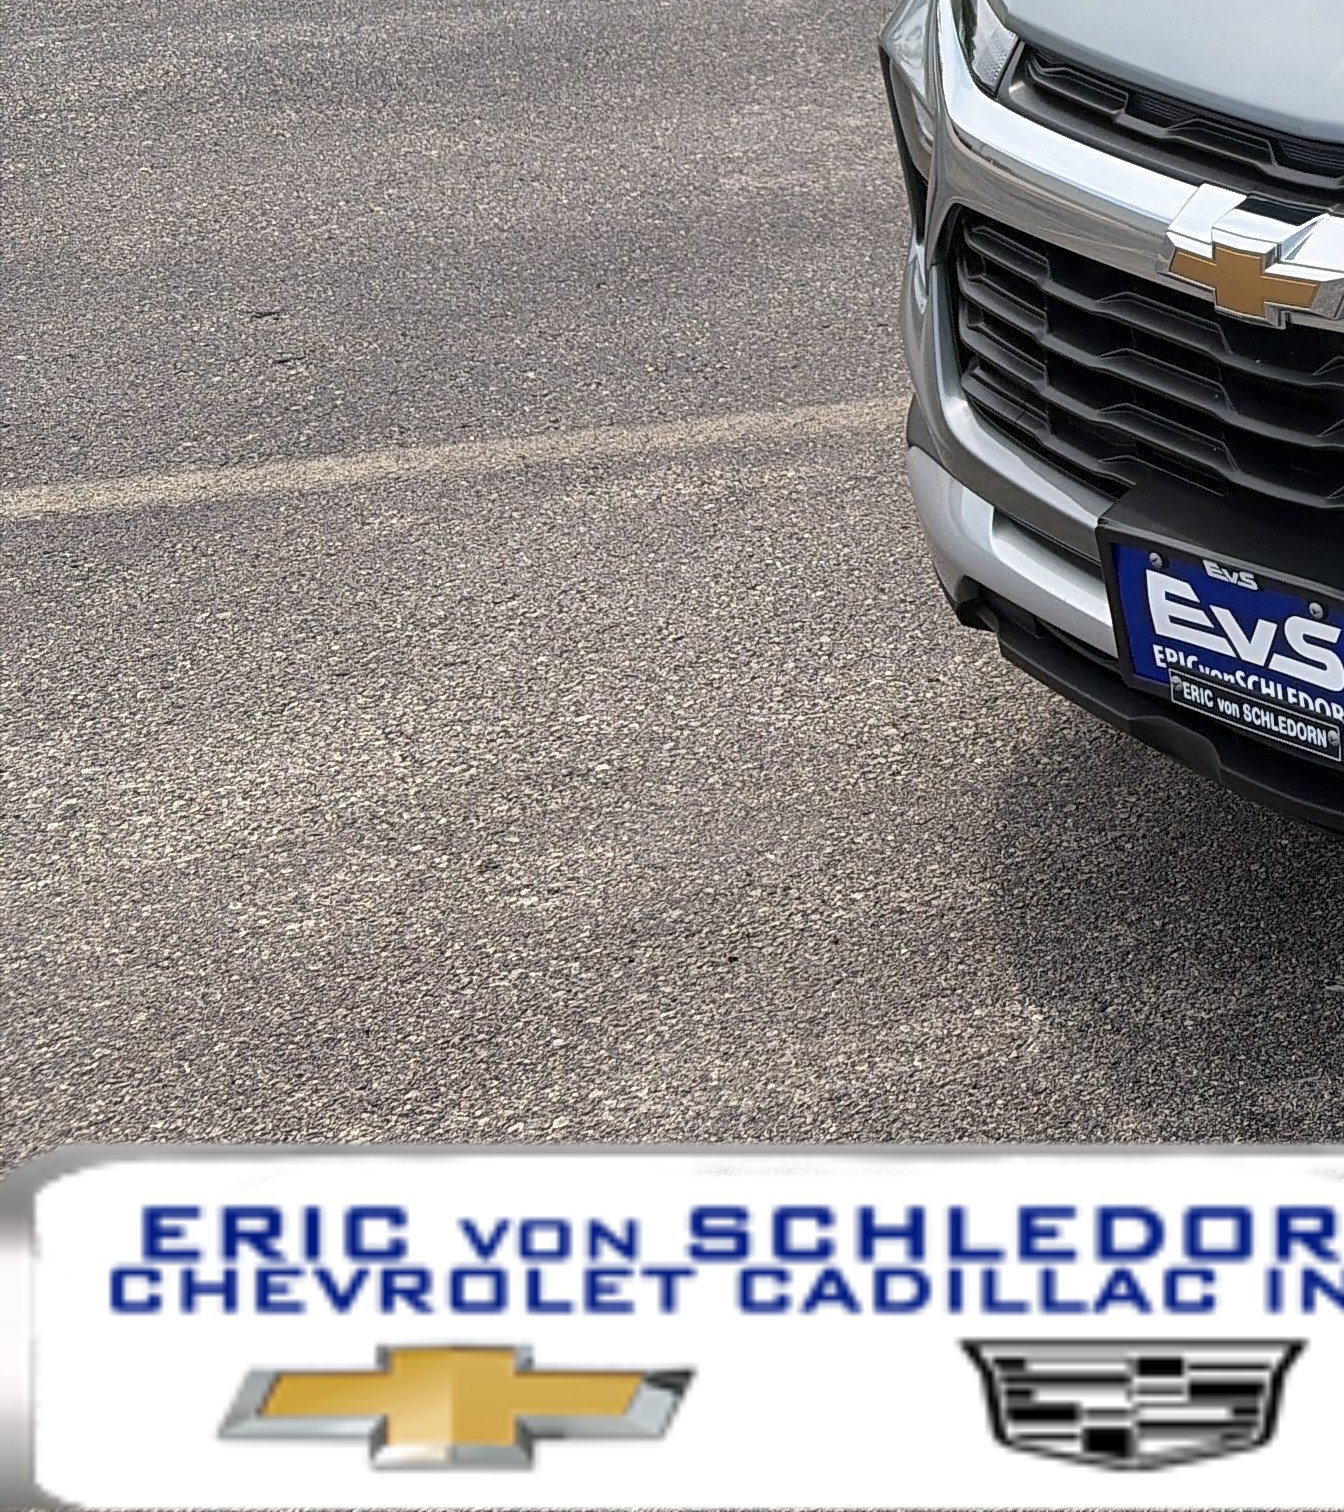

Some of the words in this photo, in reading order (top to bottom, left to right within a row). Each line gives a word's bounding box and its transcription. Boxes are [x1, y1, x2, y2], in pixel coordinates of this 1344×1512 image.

[1182, 681, 1214, 708] ERIC
[1217, 697, 1240, 719] von
[1243, 703, 1328, 748] SCHLEDORN
